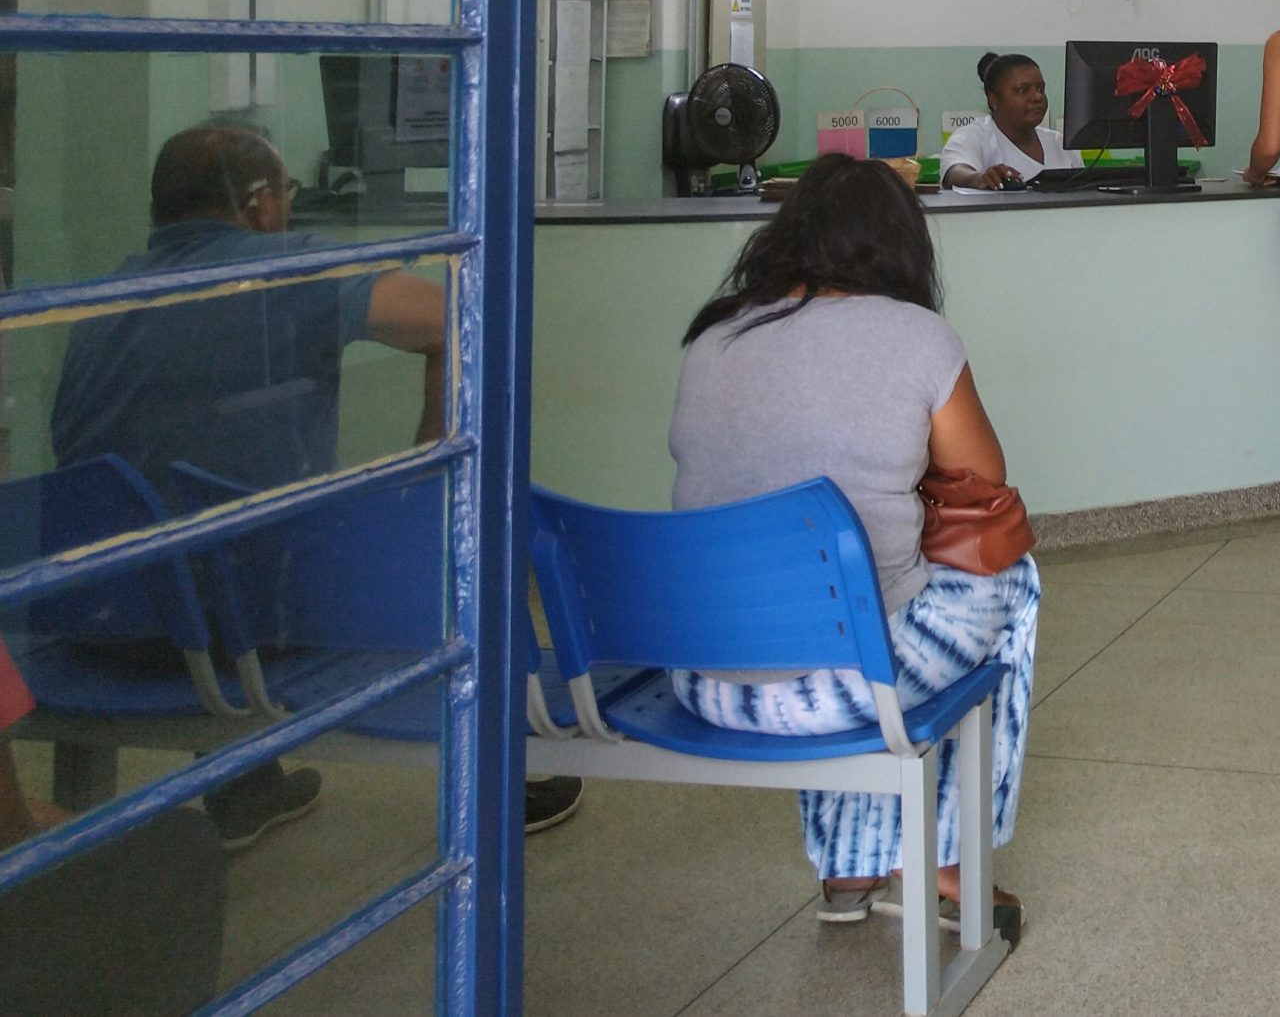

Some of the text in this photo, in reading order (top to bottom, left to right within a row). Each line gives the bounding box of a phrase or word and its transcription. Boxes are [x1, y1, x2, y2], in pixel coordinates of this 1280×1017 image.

[1131, 48, 1159, 62] AOC
[832, 116, 857, 127] 5000
[876, 117, 900, 126] 6000
[951, 117, 975, 127] 7000
